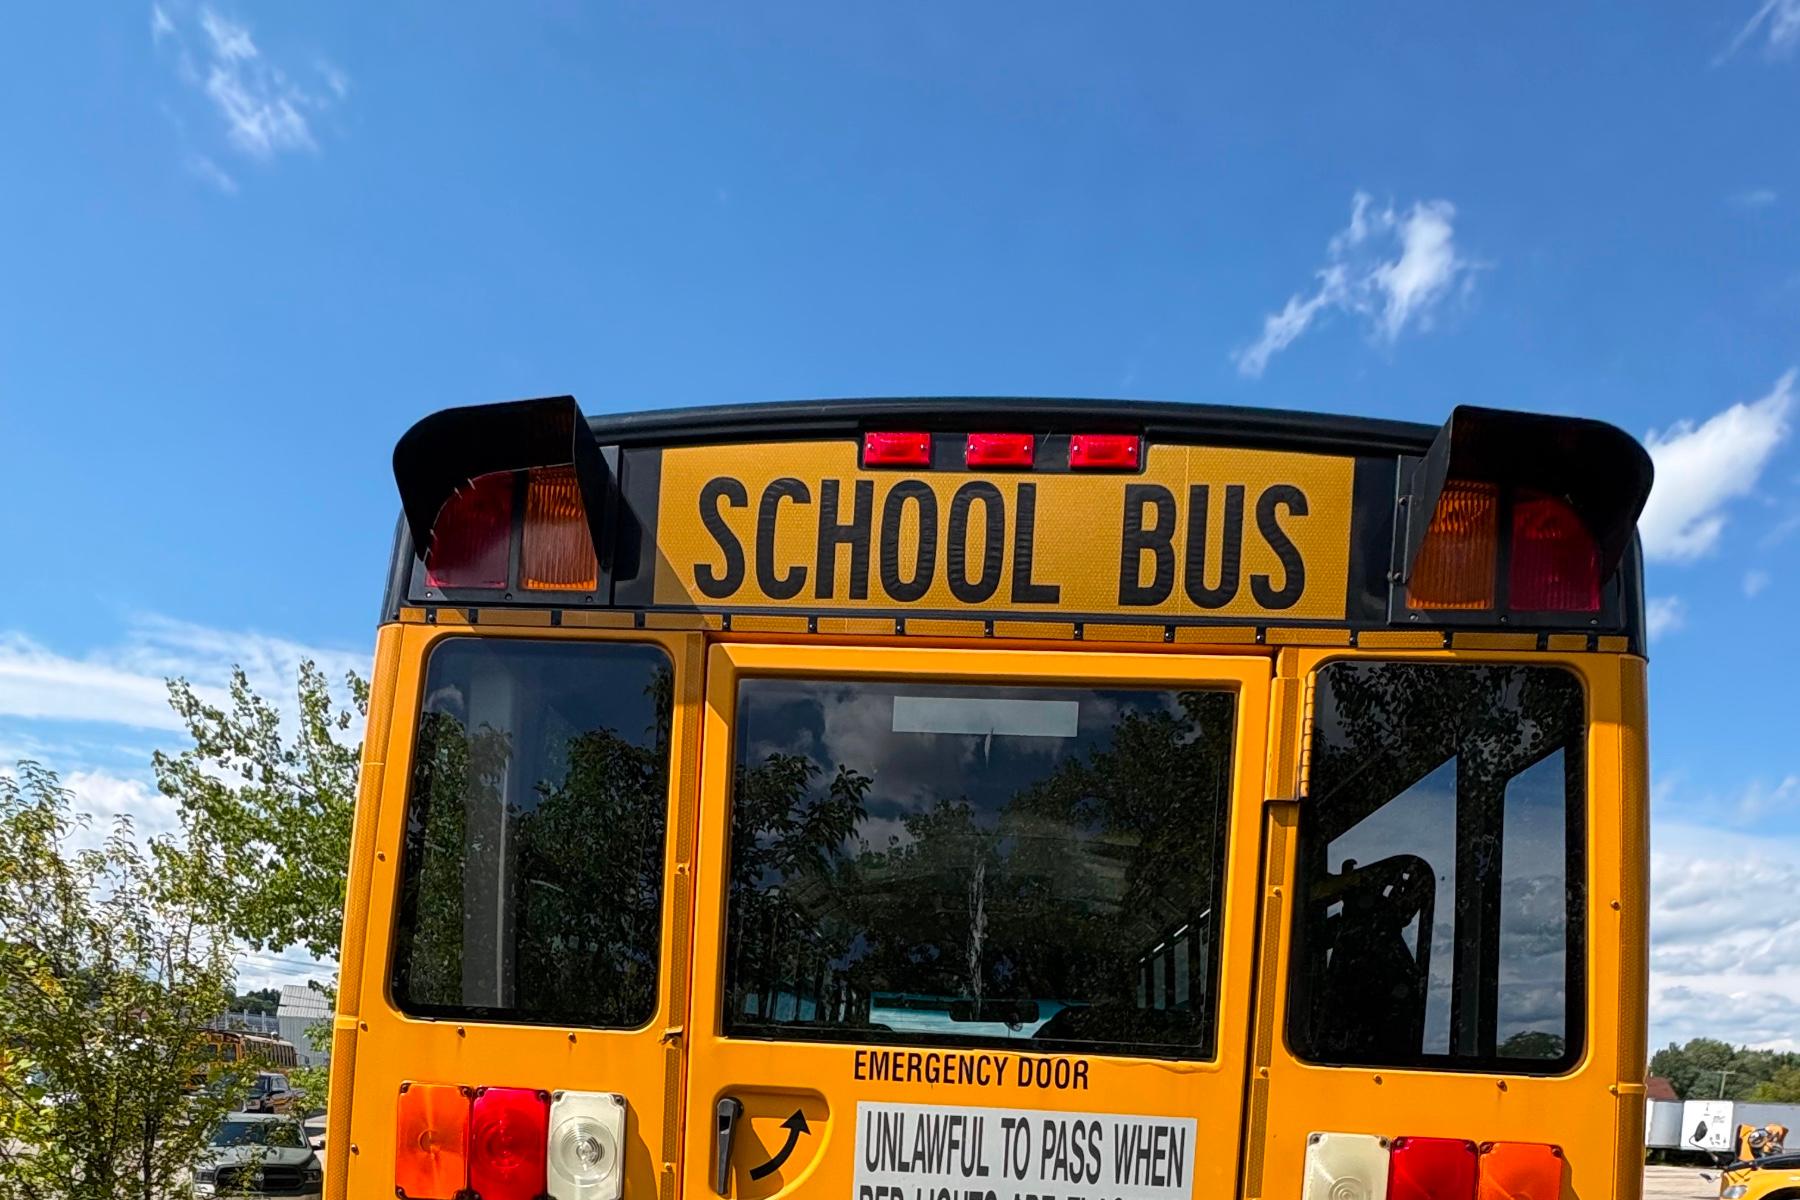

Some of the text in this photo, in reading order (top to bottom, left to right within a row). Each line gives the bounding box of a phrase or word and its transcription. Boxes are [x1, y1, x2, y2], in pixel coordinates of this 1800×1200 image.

[693, 476, 1309, 611] SCHOOL BUS
[853, 1050, 1090, 1090] EMERGENCY DOOR
[864, 1110, 1187, 1188] UNLAWFUL TO PASS WHEN
